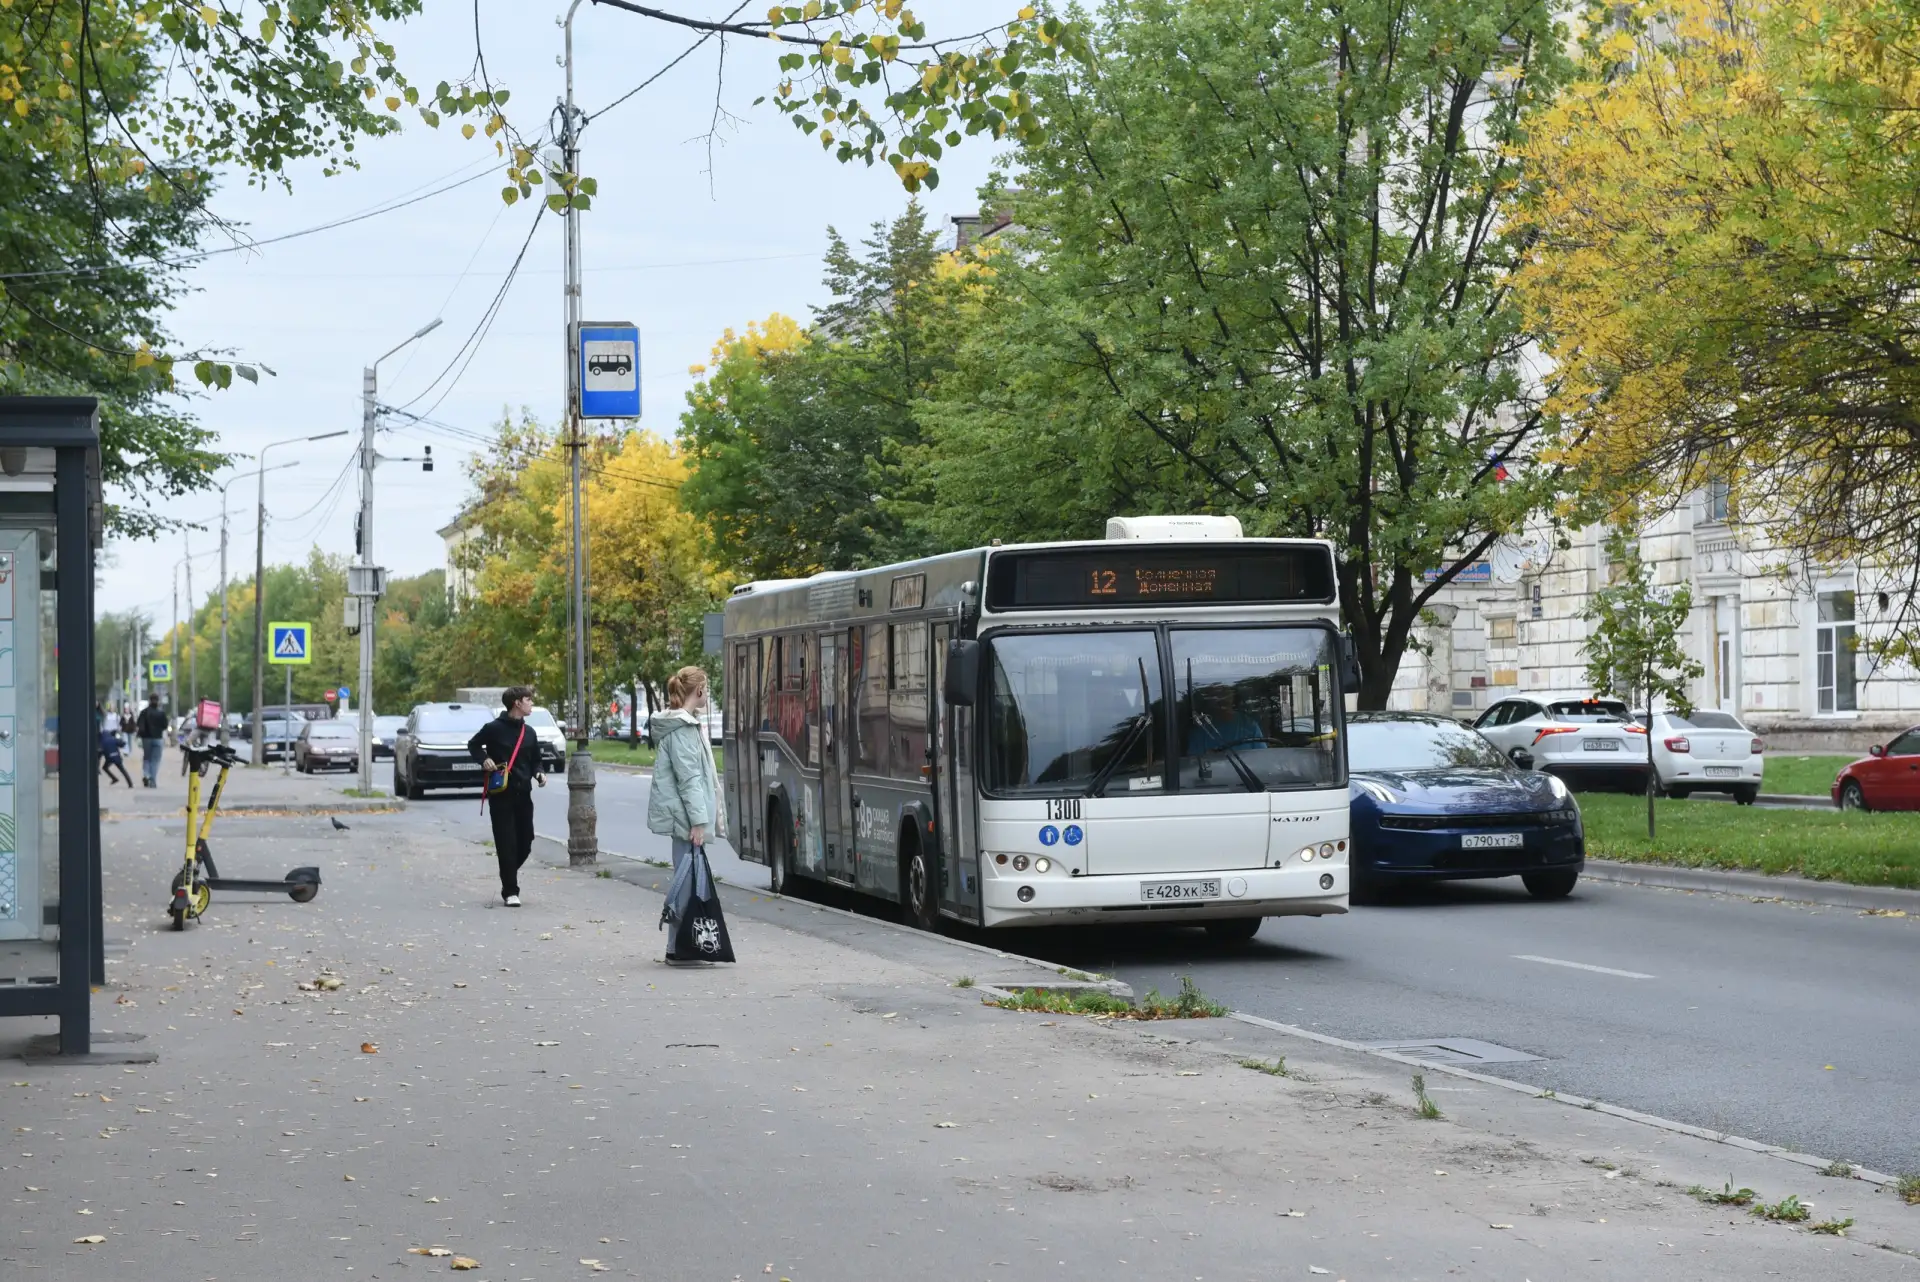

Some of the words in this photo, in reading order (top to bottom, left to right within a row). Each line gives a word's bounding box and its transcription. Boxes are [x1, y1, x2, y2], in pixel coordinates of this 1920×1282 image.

[1091, 570, 1117, 594] 12
[1139, 582, 1212, 594] Доменная
[1046, 799, 1081, 820] 1300
[1202, 882, 1215, 893] 35
